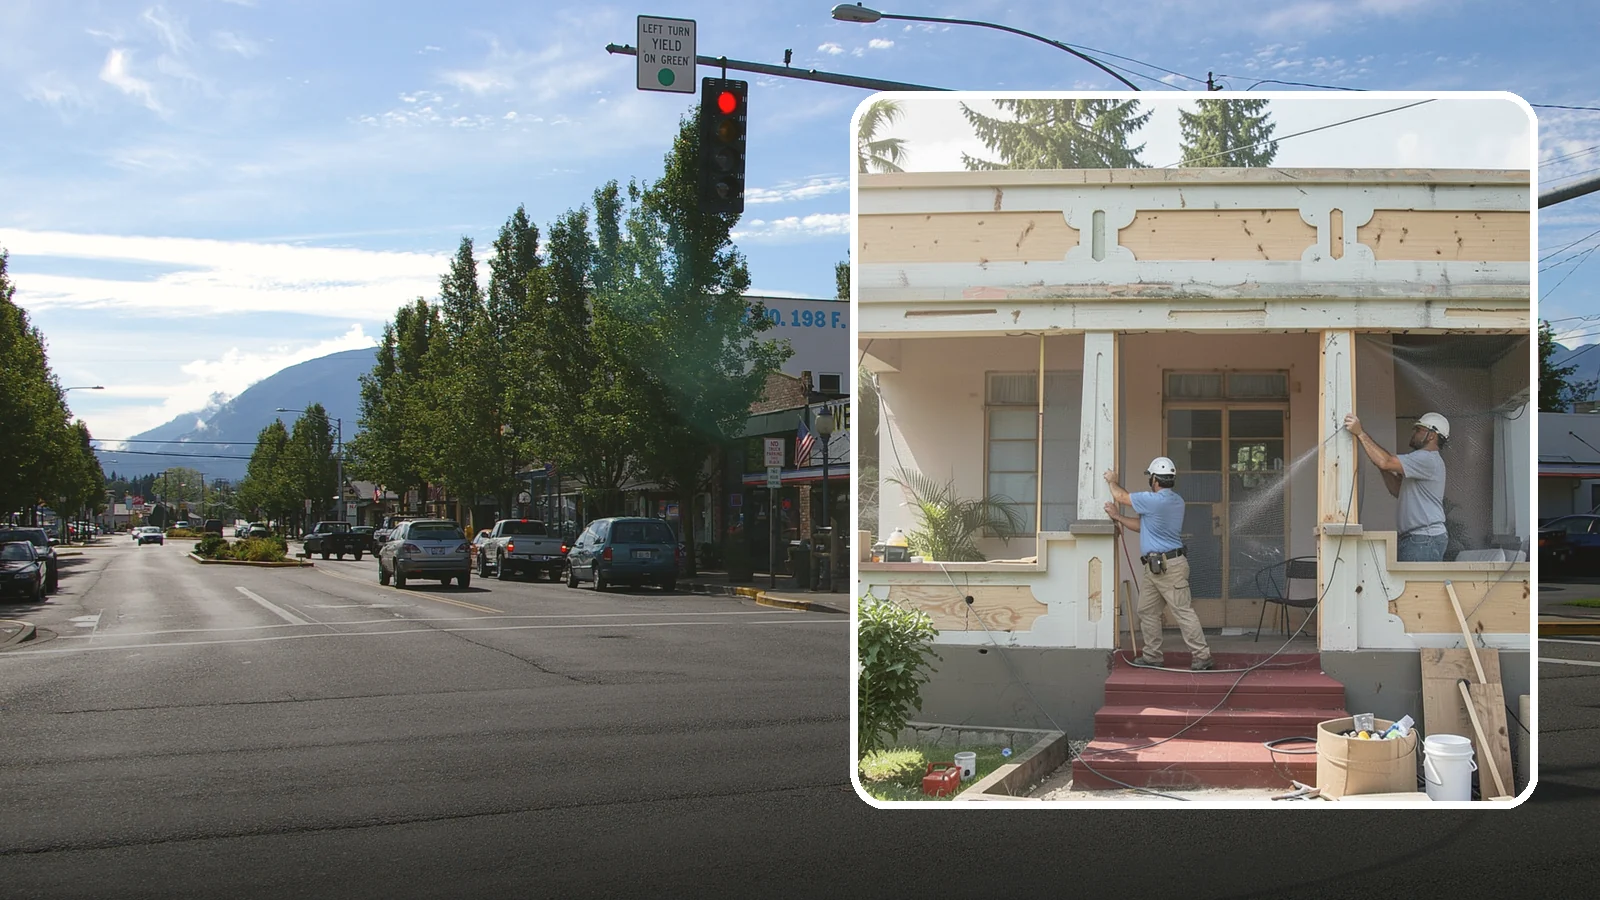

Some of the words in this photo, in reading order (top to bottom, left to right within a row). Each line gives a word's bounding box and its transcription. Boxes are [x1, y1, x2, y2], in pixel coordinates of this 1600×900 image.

[643, 24, 663, 34] LEFT
[668, 26, 690, 36] TURN
[652, 38, 681, 51] YIELD
[644, 53, 656, 63] ON
[661, 55, 689, 66] GREEN
[791, 309, 826, 328] 198
